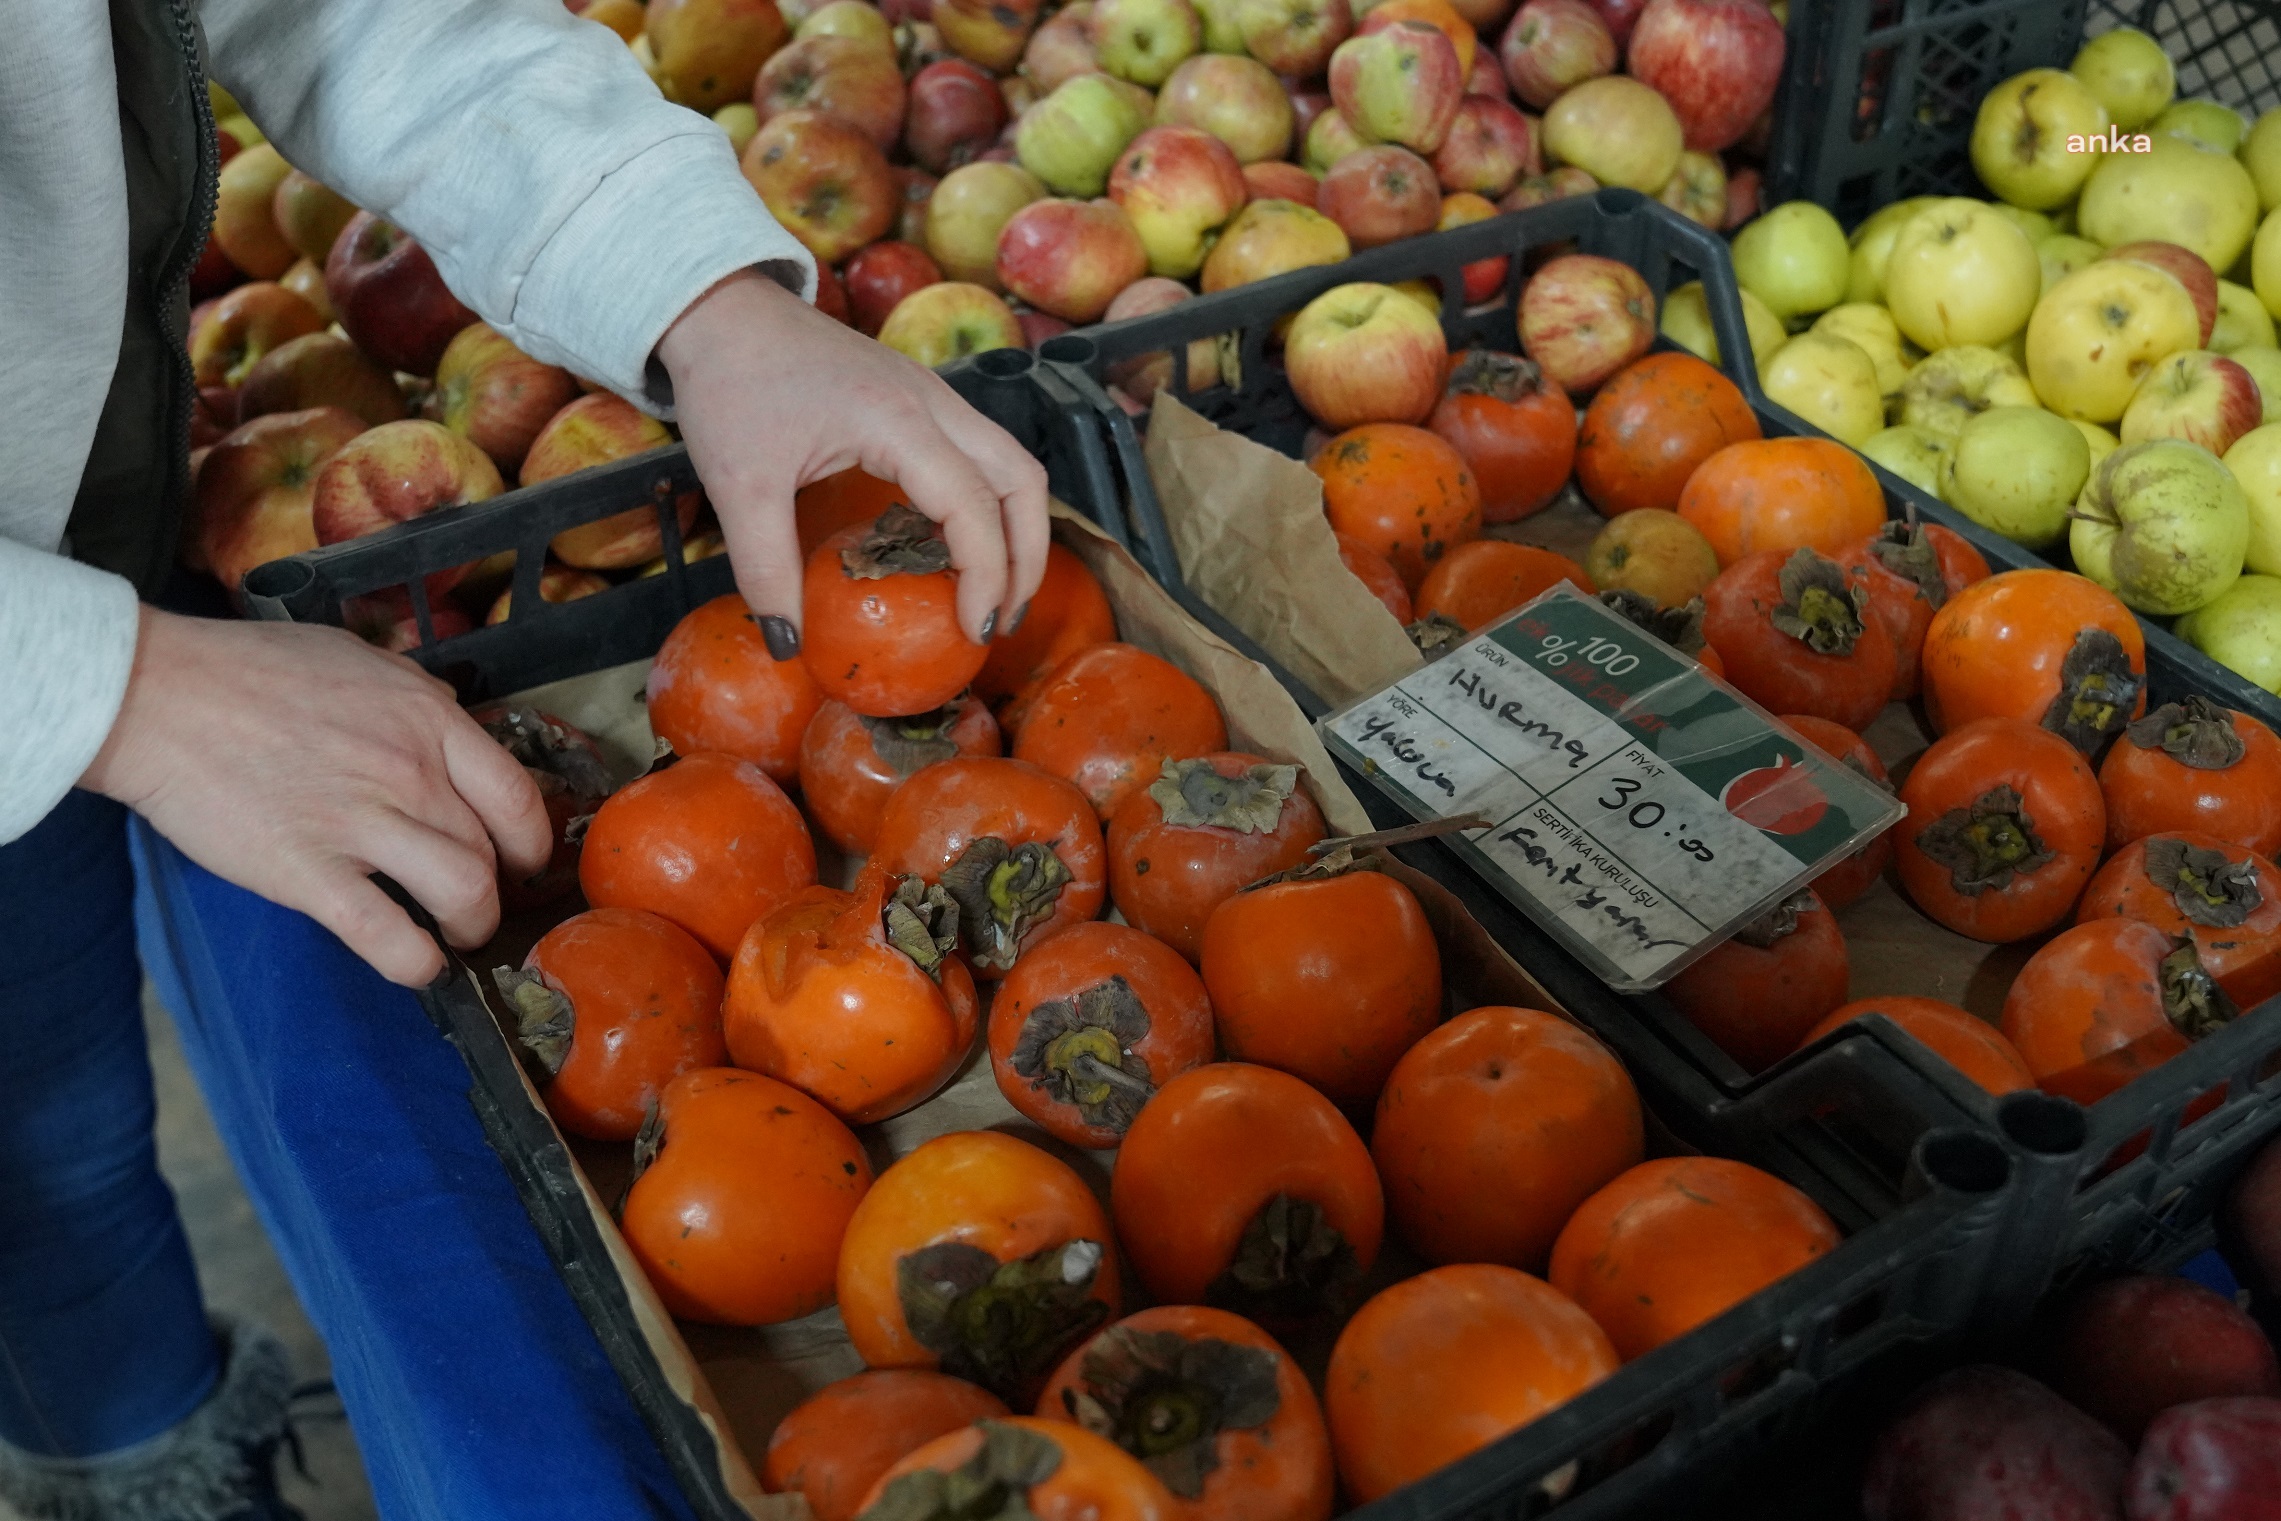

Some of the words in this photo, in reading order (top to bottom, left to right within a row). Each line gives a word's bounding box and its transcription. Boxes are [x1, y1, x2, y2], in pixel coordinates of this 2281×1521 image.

[1475, 643, 1510, 668] ÜRÜN
[1386, 694, 1418, 719] YÖRE
[1625, 750, 1665, 778] FİYAT
[1589, 854, 1659, 908] KURULUŞU
